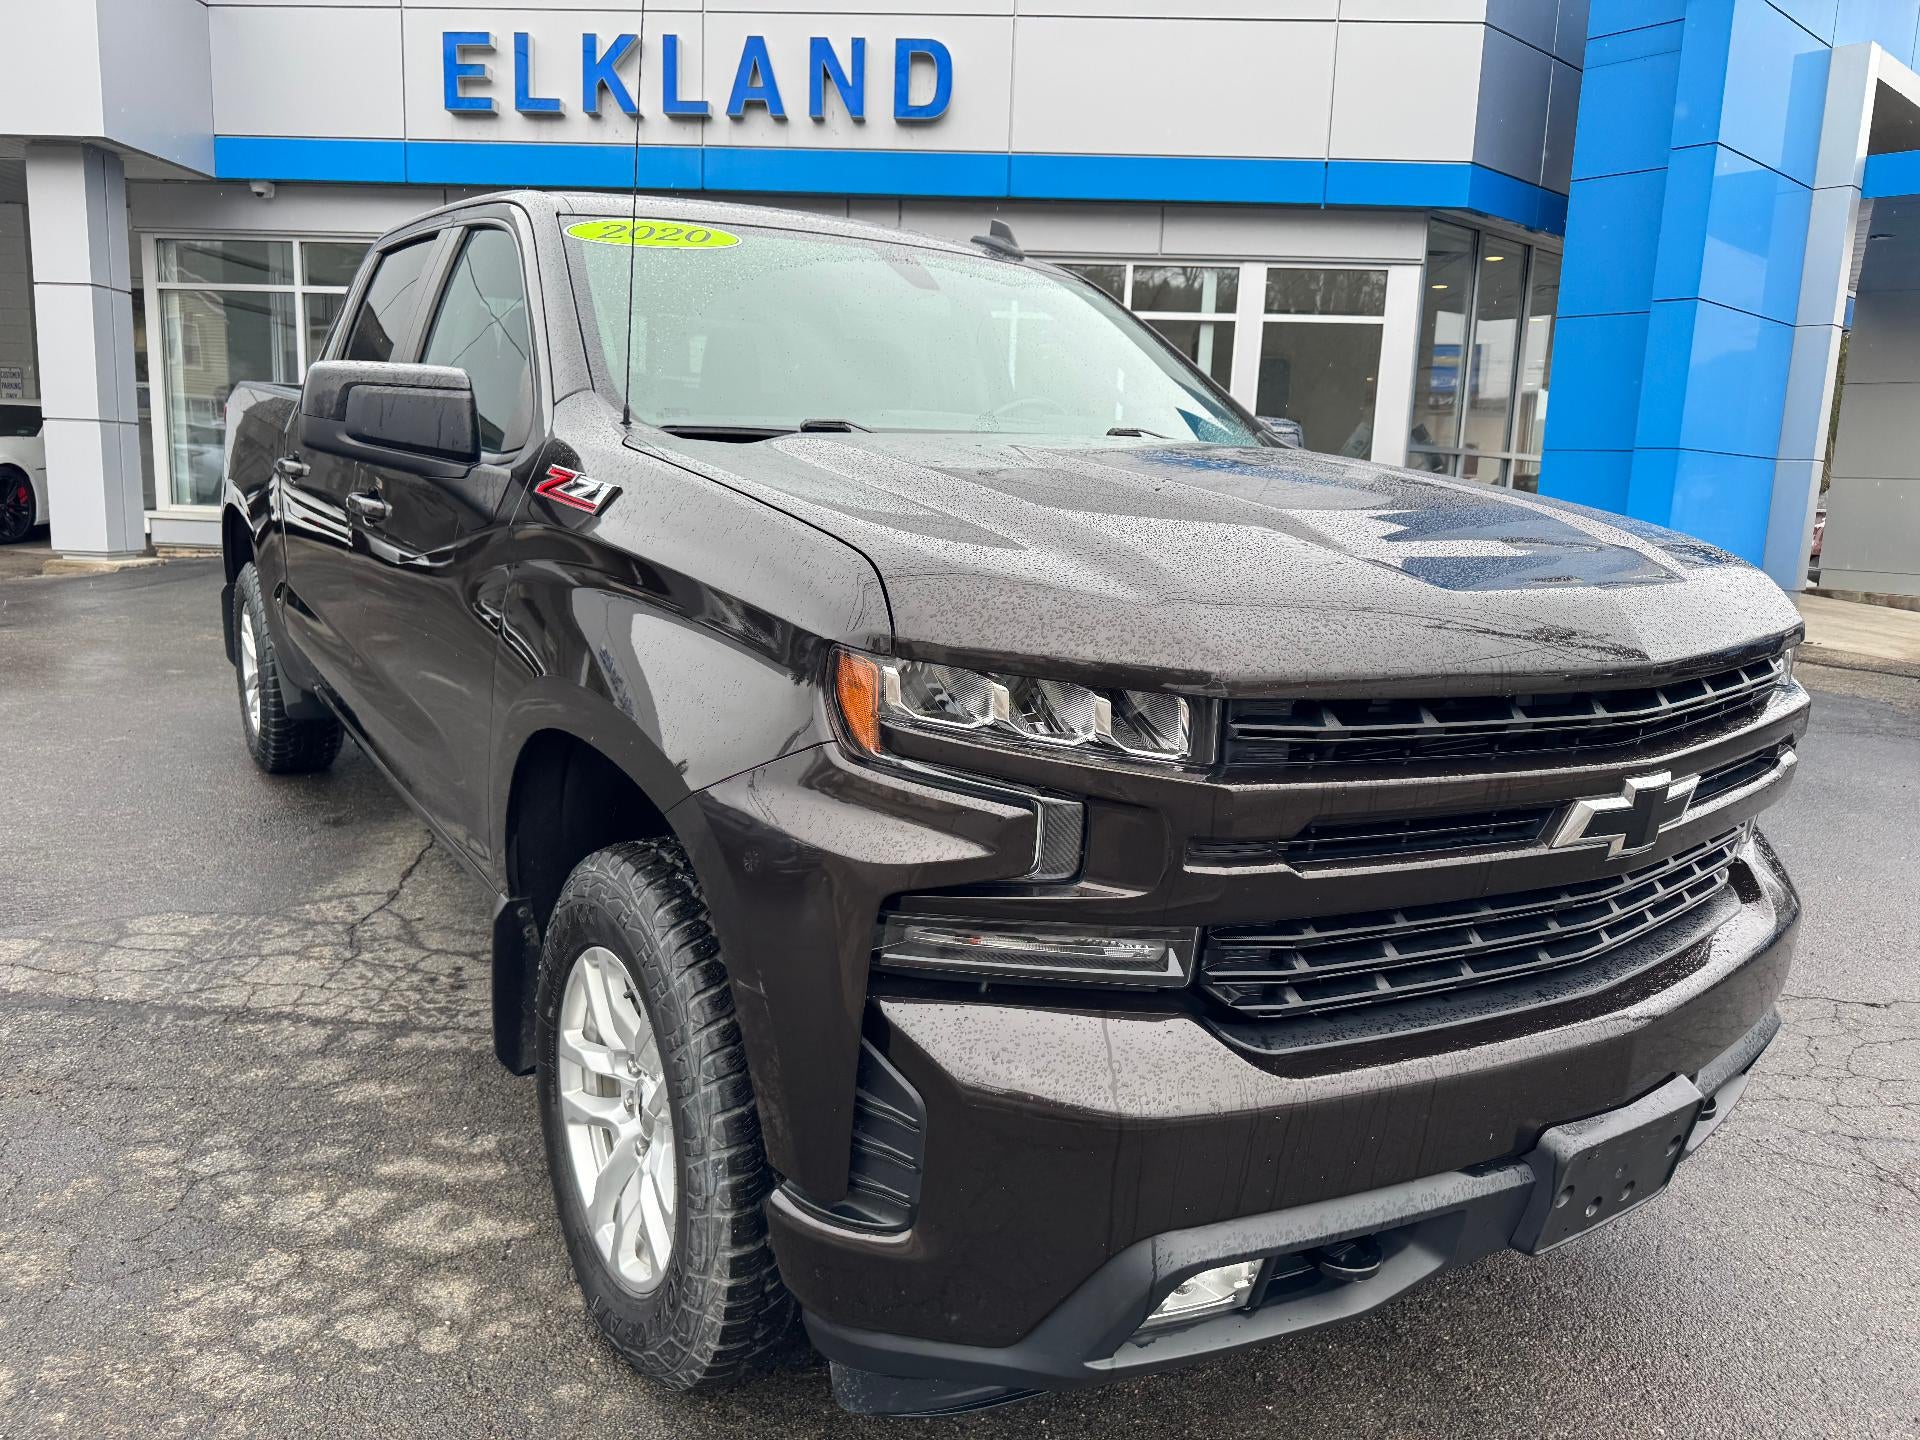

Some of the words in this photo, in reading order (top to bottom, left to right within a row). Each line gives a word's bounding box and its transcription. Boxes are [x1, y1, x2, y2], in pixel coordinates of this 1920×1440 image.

[442, 31, 954, 125] ELKLAND
[597, 224, 712, 243] 2020
[1, 382, 22, 390] PARKING
[535, 463, 624, 517] Z71
